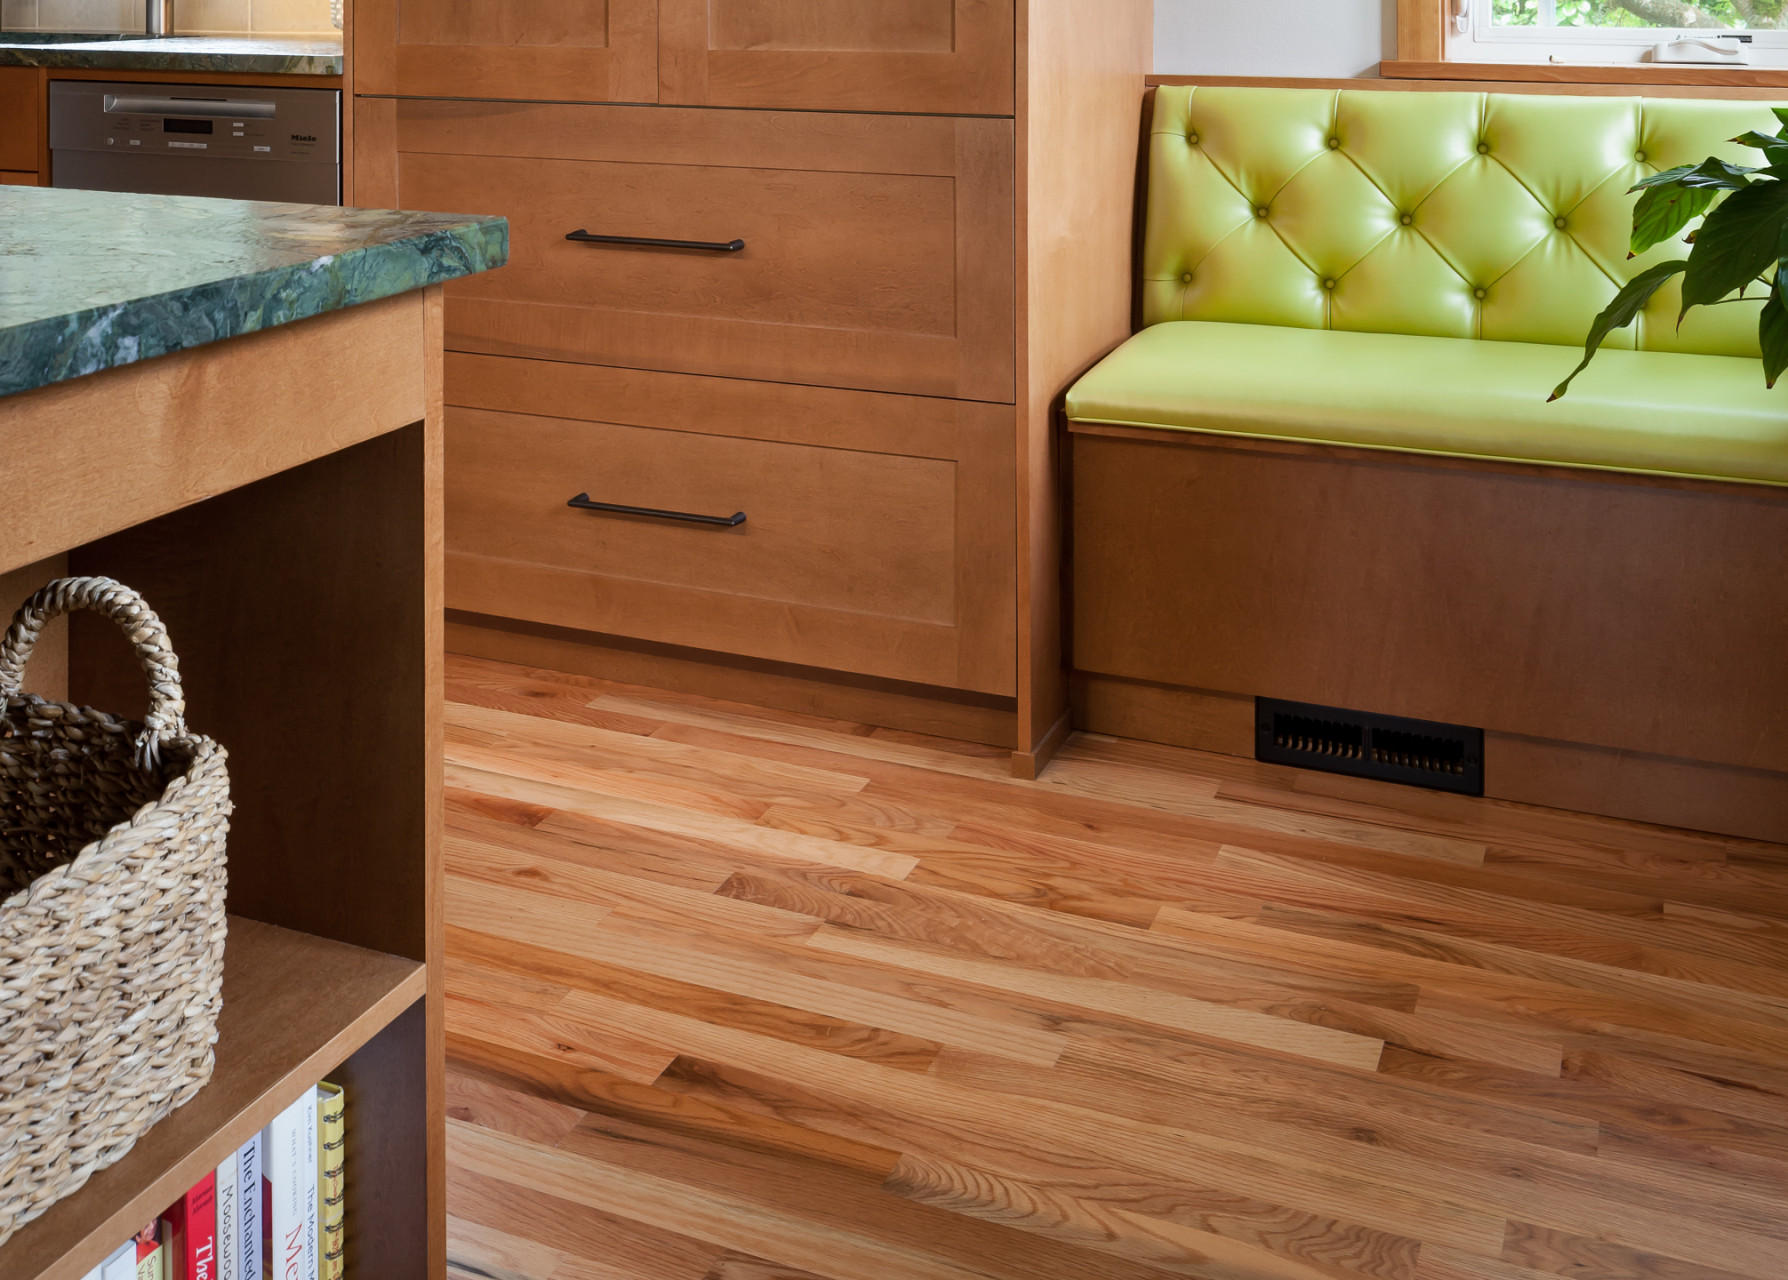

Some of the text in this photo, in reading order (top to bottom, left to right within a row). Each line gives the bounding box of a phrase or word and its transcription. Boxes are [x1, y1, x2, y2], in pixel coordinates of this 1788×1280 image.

[290, 134, 317, 142] Miele
[243, 1141, 257, 1280] The Enchanted
[307, 1184, 315, 1212] The
[286, 1222, 302, 1280] Me
[307, 1213, 316, 1269] Modern
